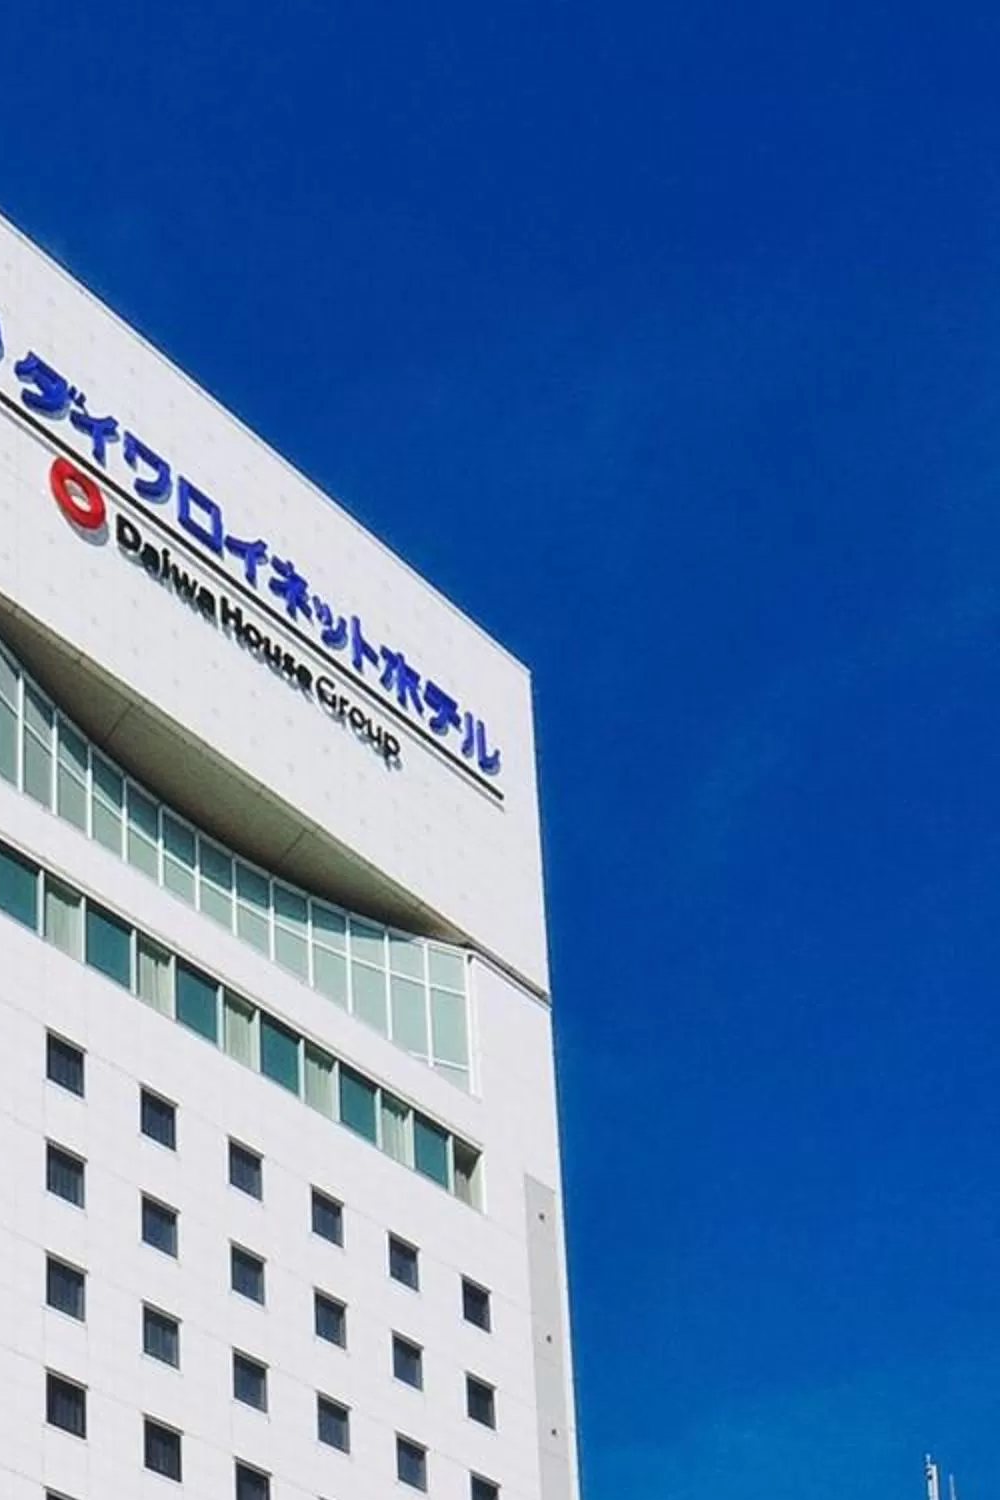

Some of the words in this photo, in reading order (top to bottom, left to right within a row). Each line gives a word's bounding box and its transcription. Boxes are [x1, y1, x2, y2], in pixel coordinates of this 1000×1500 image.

[14, 352, 500, 772] ダイワロイネットホテル
[116, 513, 218, 616] Daiwa
[220, 597, 314, 693] House
[315, 676, 401, 757] Group
